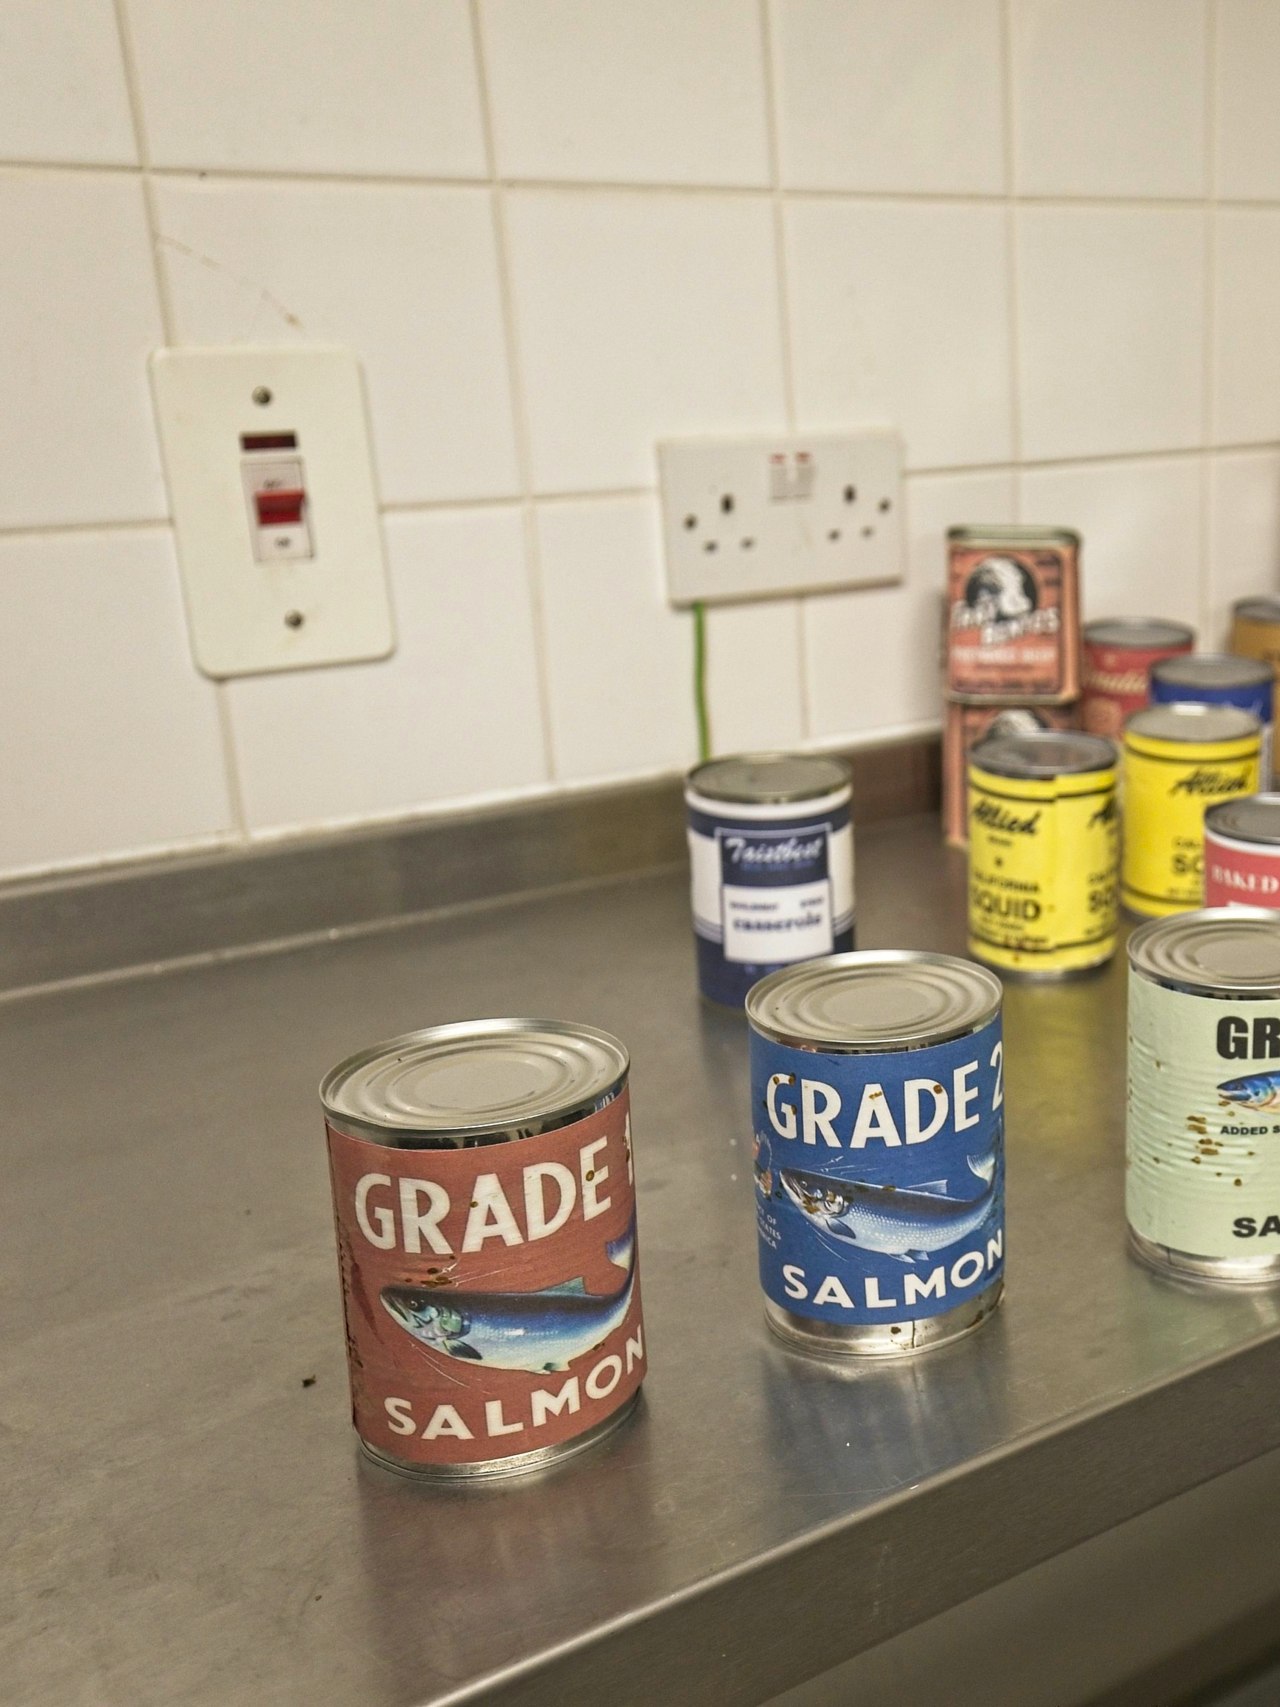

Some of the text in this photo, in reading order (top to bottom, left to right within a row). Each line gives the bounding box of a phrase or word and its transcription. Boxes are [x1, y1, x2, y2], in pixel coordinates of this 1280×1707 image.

[766, 1060, 981, 1149] GRADE
[1220, 1125, 1269, 1136] ADDED
[354, 1136, 612, 1255] GRADE
[384, 1324, 645, 1441] SALMON
